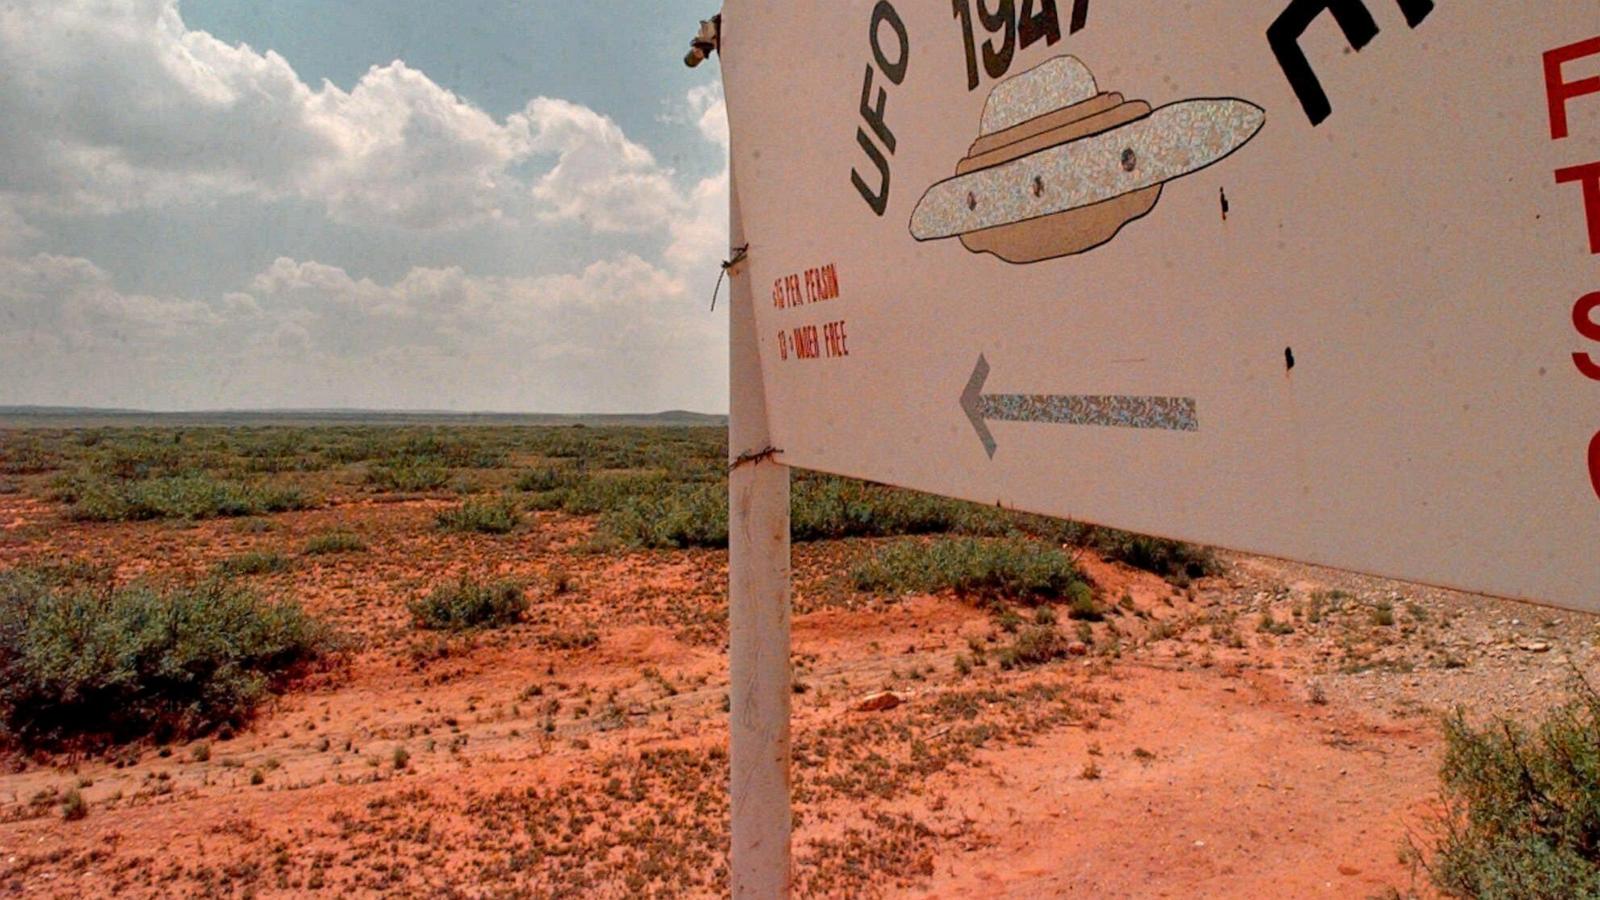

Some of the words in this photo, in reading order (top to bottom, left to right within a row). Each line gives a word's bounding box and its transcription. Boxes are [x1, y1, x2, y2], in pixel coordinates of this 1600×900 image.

[851, 0, 909, 216] UFO
[784, 273, 804, 308] PER
[804, 263, 839, 304] PERSON
[793, 325, 820, 360] UNDER
[823, 320, 849, 358] FREE
